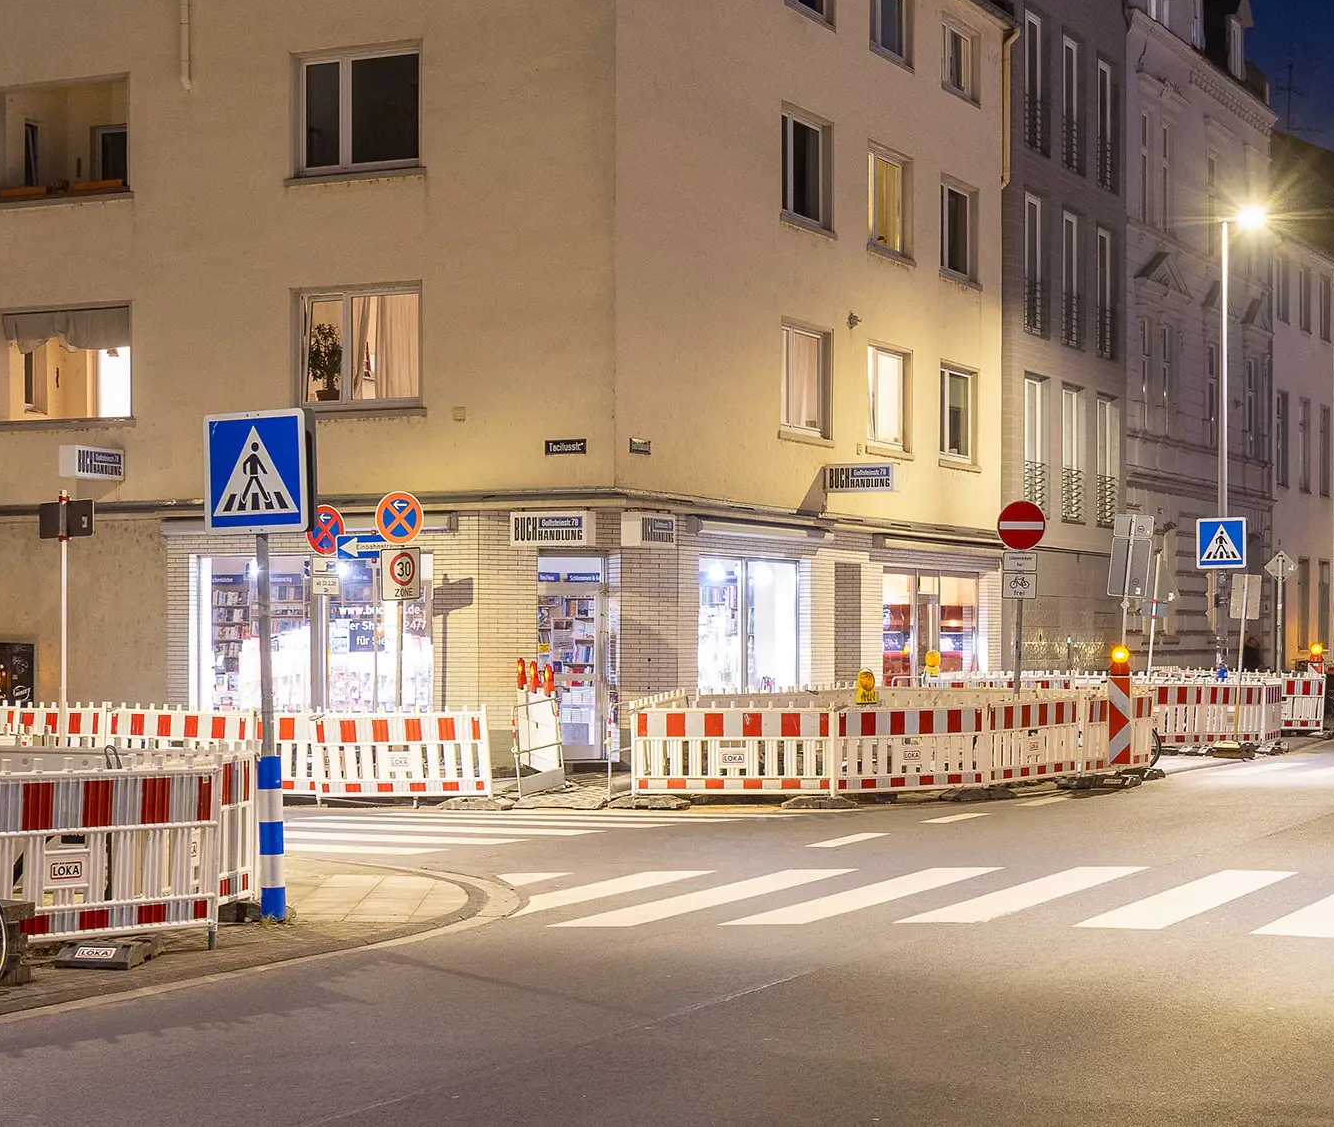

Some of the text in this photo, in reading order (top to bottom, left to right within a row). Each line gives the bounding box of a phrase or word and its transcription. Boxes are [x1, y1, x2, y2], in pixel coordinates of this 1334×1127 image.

[77, 449, 93, 474] BUCH
[93, 463, 122, 476] HANDLUNG
[829, 467, 850, 488] BUCH
[850, 477, 890, 488] HANDLUNG
[514, 516, 538, 541] BUCH
[537, 529, 583, 541] HANDLUNG
[397, 561, 412, 577] 30
[394, 587, 413, 598] ZONE
[356, 635, 369, 646] für
